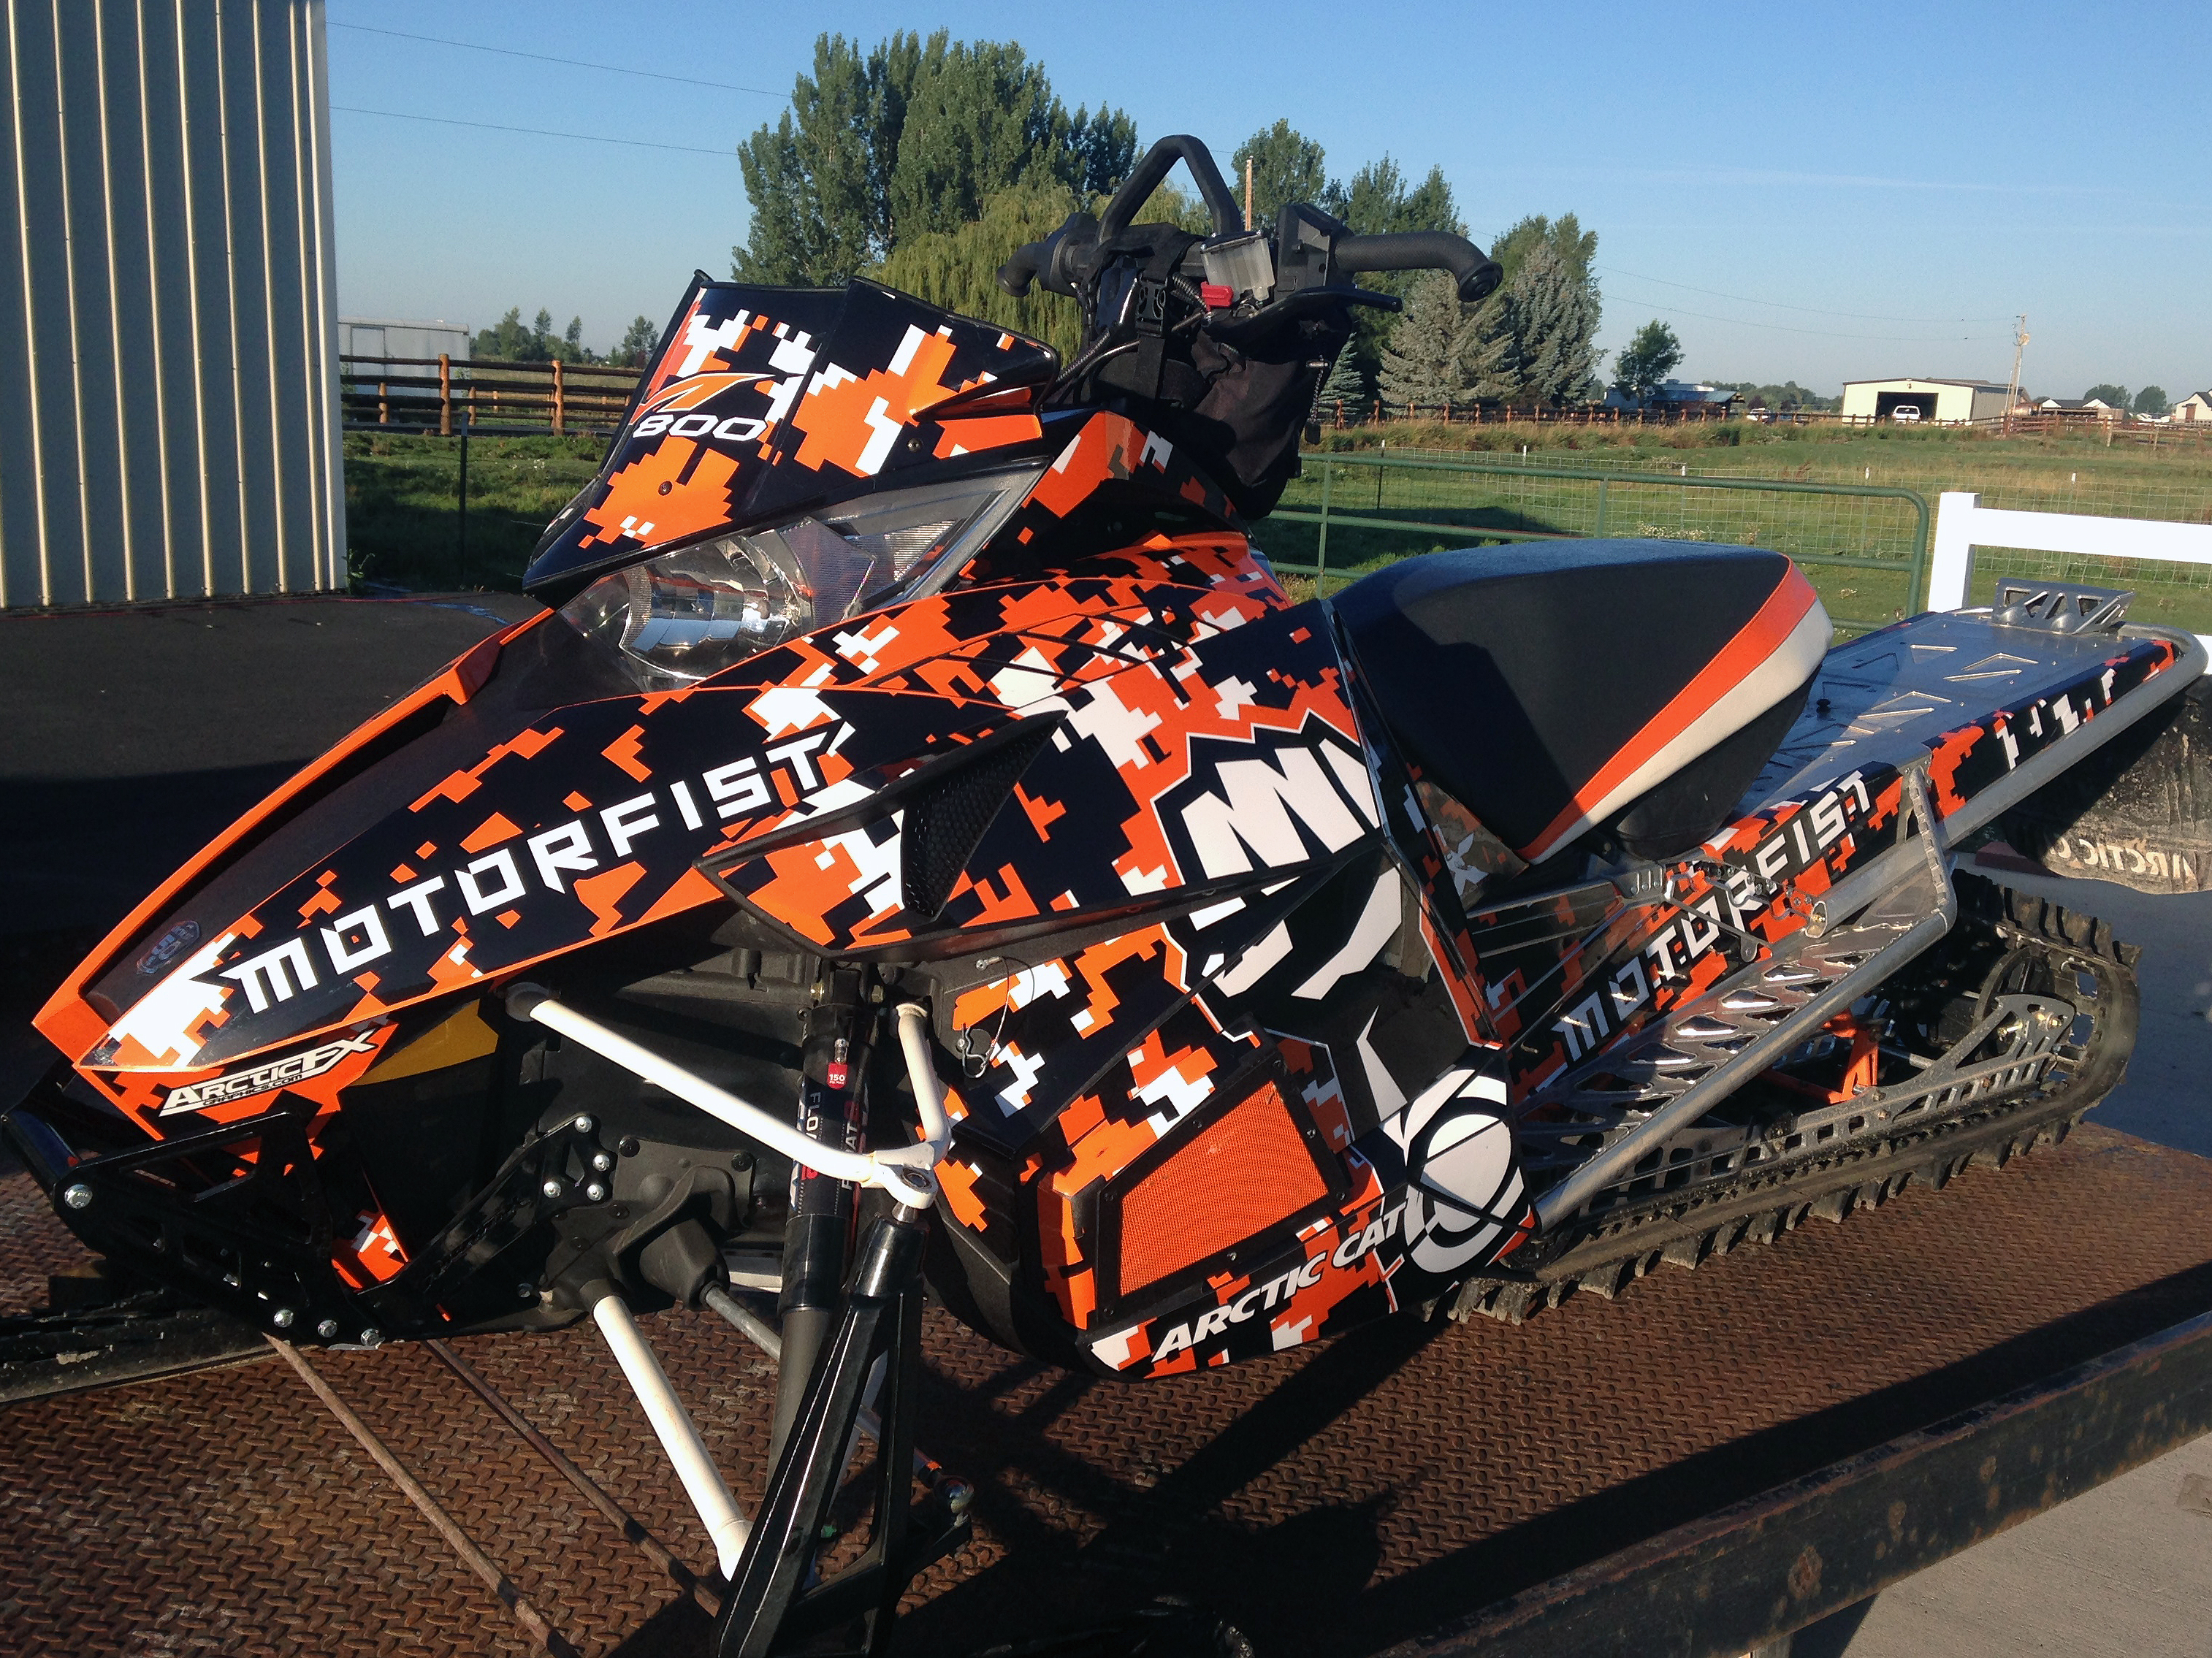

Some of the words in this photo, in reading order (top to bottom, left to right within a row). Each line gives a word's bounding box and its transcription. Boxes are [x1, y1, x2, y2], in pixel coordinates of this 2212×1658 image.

[633, 414, 767, 441] 800
[222, 721, 856, 1013] MOTORFIST
[1552, 771, 1871, 1062] MOTORFIST
[828, 1074, 846, 1082] 150
[1151, 1253, 1326, 1363] ARCTIC
[1332, 1203, 1408, 1267] CAT
